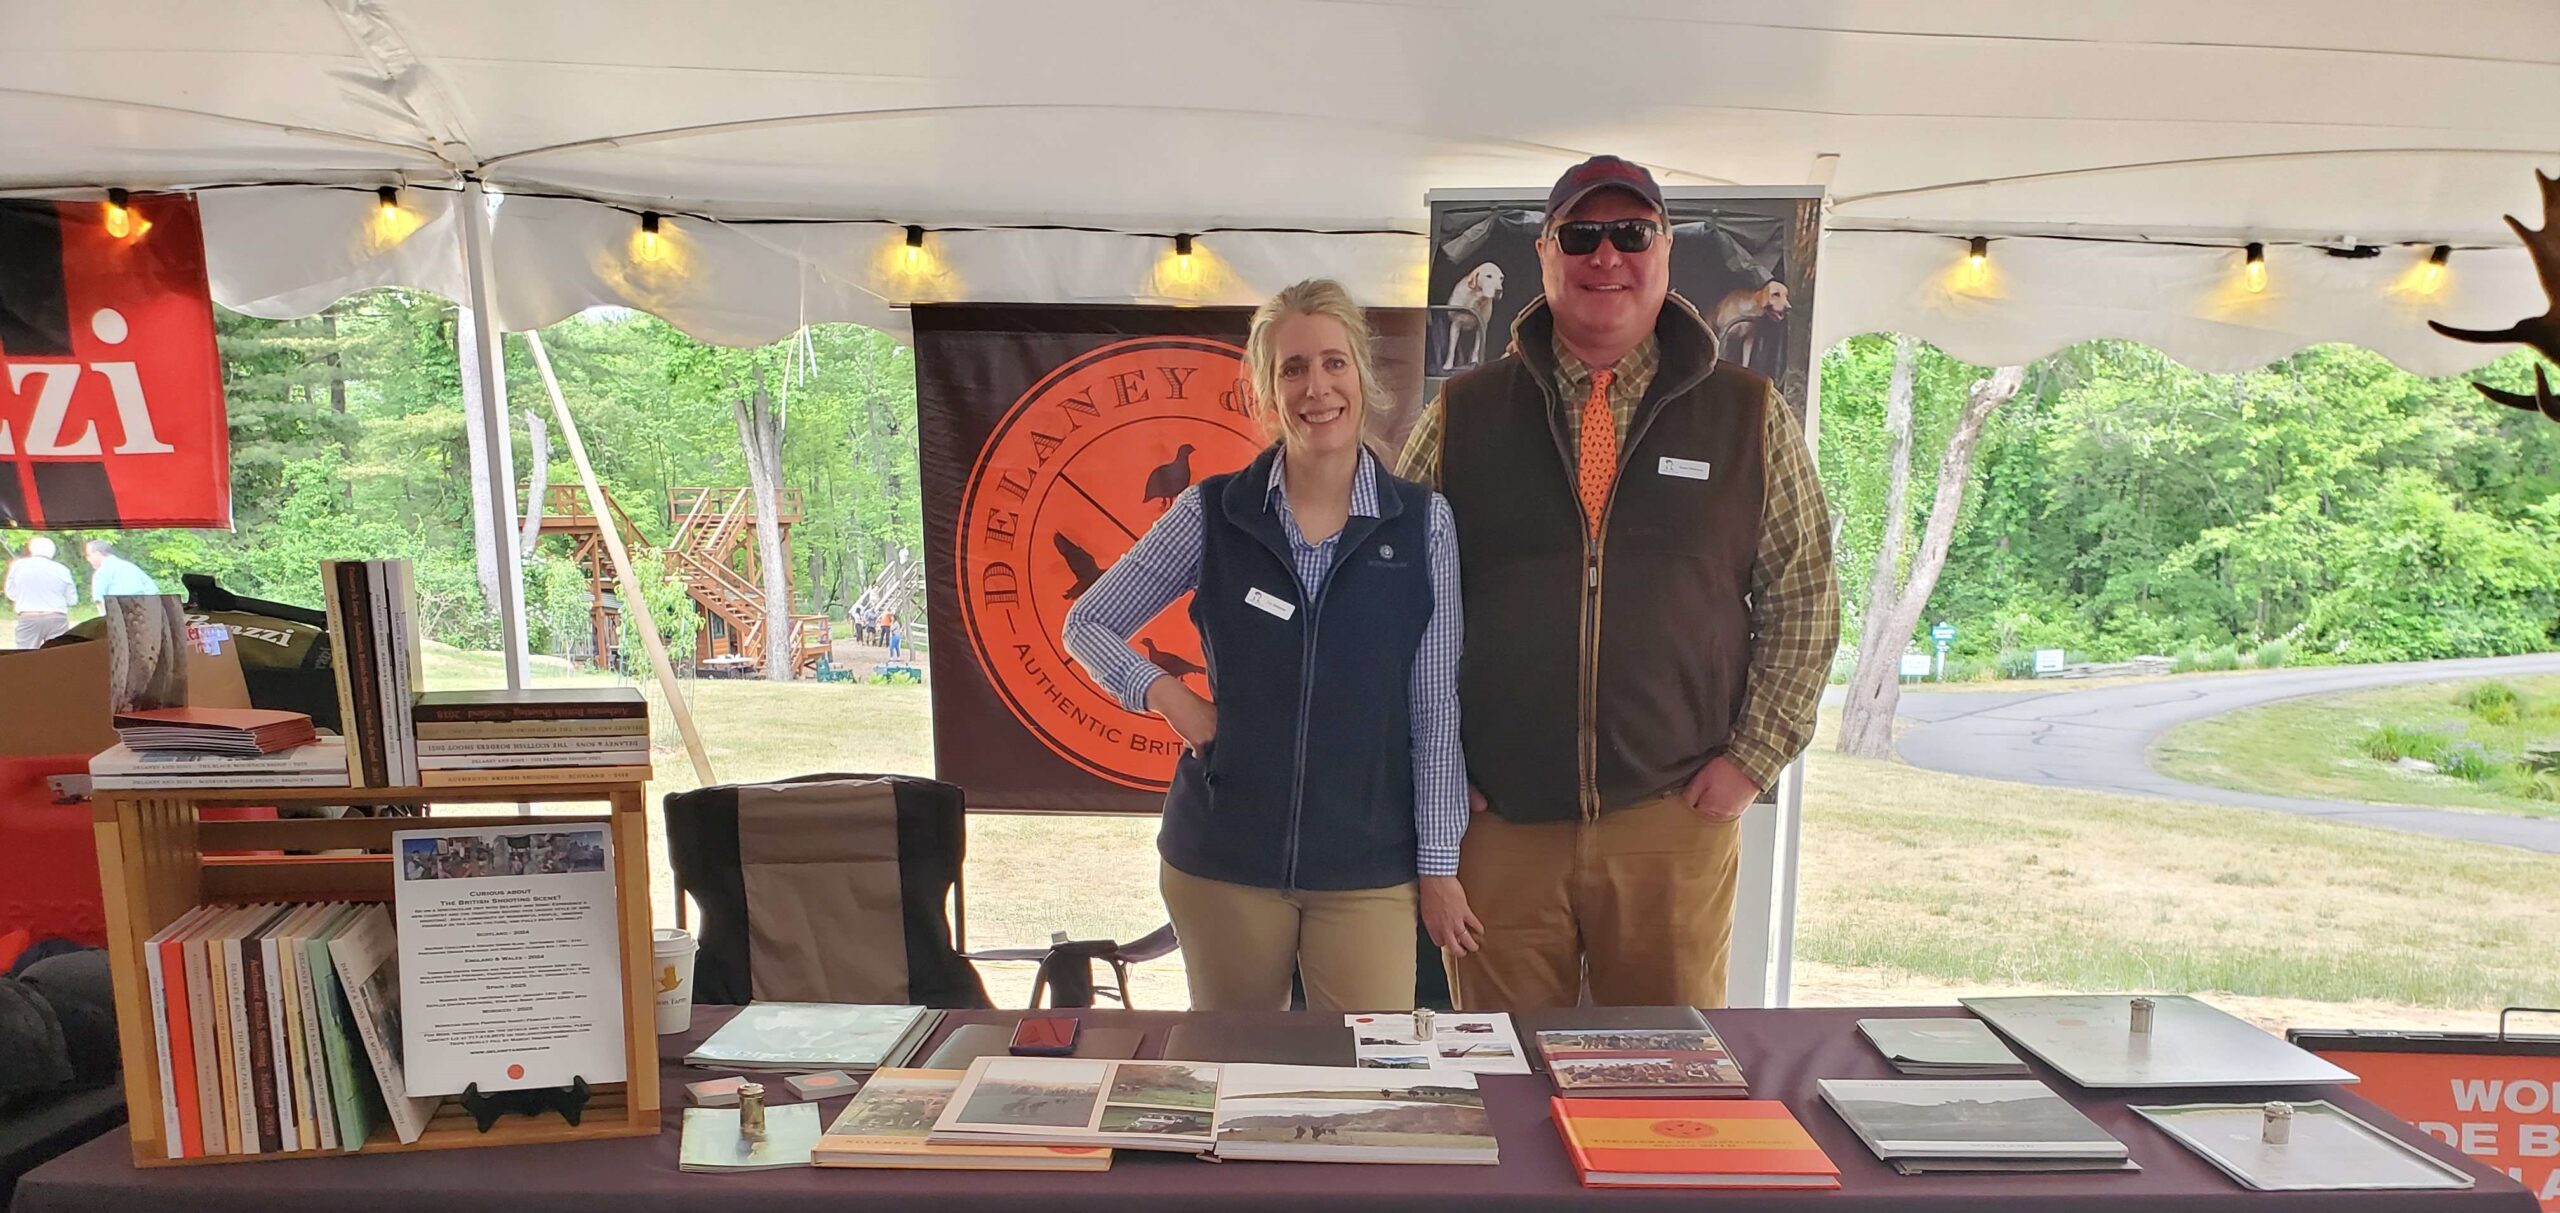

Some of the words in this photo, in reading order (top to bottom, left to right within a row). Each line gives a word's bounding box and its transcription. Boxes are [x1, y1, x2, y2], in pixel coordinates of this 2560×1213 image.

[0, 308, 174, 456] zi
[982, 366, 1198, 612] DELANEY
[1013, 643, 1123, 744] AUTHENTIC
[555, 707, 584, 717] British
[447, 743, 474, 751] SHOOT
[477, 742, 511, 750] BORDERS
[514, 742, 550, 750] SCOTTISH
[553, 741, 567, 749] THE
[604, 740, 638, 748] DELANEY
[448, 775, 489, 783] AUTHENTIC
[568, 771, 604, 779] SCOTLAND
[458, 898, 489, 906] BRITISH
[492, 896, 530, 904] SHOOTING
[506, 888, 531, 896] ABOUT
[298, 952, 309, 983] DELANEY
[231, 963, 240, 995] DELANEY
[250, 959, 263, 1001] Authentic
[304, 992, 313, 1010] SONS
[234, 1004, 243, 1022] SONS
[253, 1001, 266, 1029] British
[308, 1019, 316, 1032] THE
[340, 962, 357, 994] DELANEY
[354, 1001, 367, 1020] SONS
[364, 1026, 375, 1040] THE
[379, 1066, 391, 1083] PARK
[237, 1030, 245, 1044] THE
[310, 1034, 320, 1057] BLACK
[256, 1030, 269, 1068] Shooting
[240, 1073, 249, 1090] PARK
[260, 1072, 273, 1109] Scotland
[2451, 1079, 2560, 1114] WO
